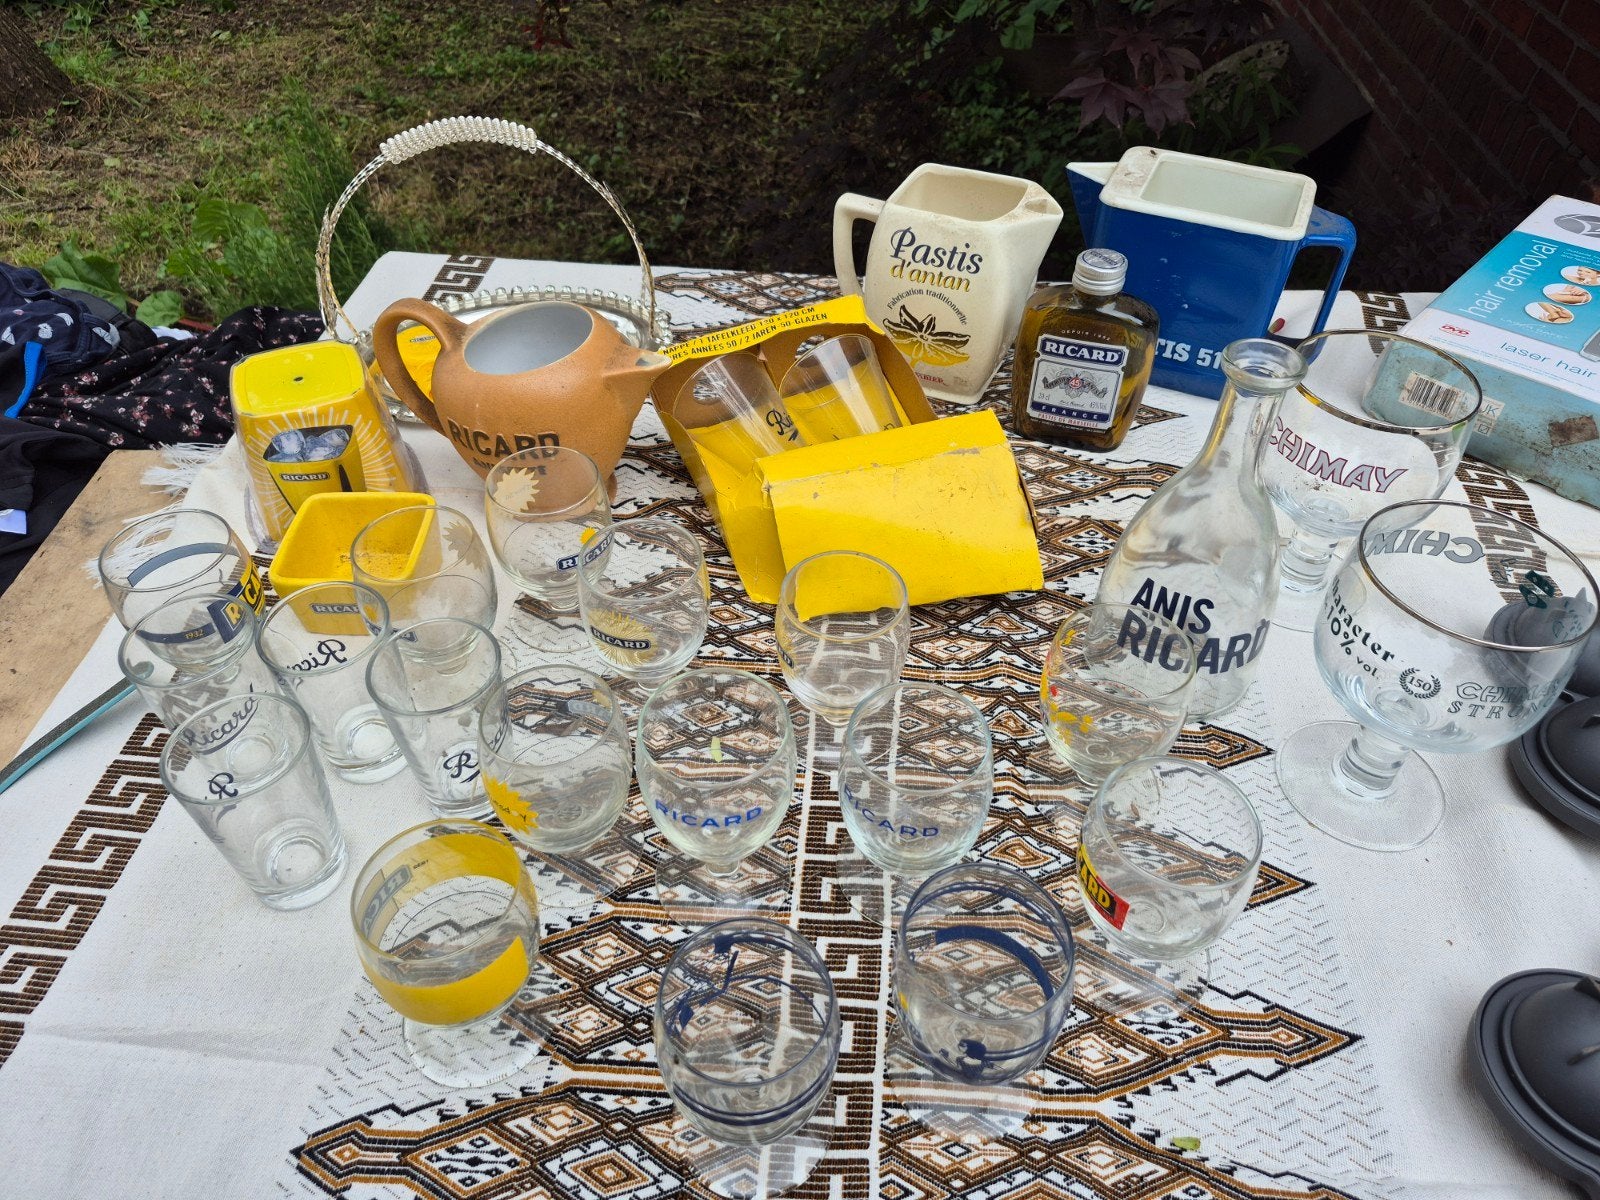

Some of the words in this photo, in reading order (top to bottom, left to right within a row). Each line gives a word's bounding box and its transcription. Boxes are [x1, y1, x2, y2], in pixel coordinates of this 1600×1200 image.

[890, 226, 983, 275] Pastis
[890, 259, 971, 293] d'antan
[1458, 289, 1506, 319] hair
[1500, 239, 1559, 292] removal
[886, 288, 924, 310] Fabrication
[926, 289, 968, 326] traditionnelle
[662, 342, 690, 355] NAPPE
[707, 323, 757, 343] TAFELKLEED
[801, 307, 815, 315] CM
[669, 350, 689, 360] RES
[1045, 341, 1119, 363] RICARD
[1154, 338, 1191, 362] TIS
[1196, 347, 1222, 370] 51
[1500, 342, 1551, 363] laser
[1556, 359, 1597, 378] hair
[1070, 379, 1080, 388] 45
[1041, 405, 1099, 420] FRANCE
[447, 416, 560, 460] RICARD
[282, 473, 327, 482] RICARD
[562, 533, 613, 568] RICAR
[315, 604, 361, 614] RICAR
[1130, 578, 1214, 634] ANIS
[1332, 577, 1395, 662] haracter
[591, 627, 649, 650] RICARD
[1117, 608, 1271, 675] RICARD
[1356, 656, 1381, 680] vol.
[1408, 676, 1432, 692] 150
[1447, 700, 1538, 719] STRON
[655, 799, 763, 828] RICARD
[844, 783, 940, 837] RICARD
[1079, 860, 1112, 910] ARD
